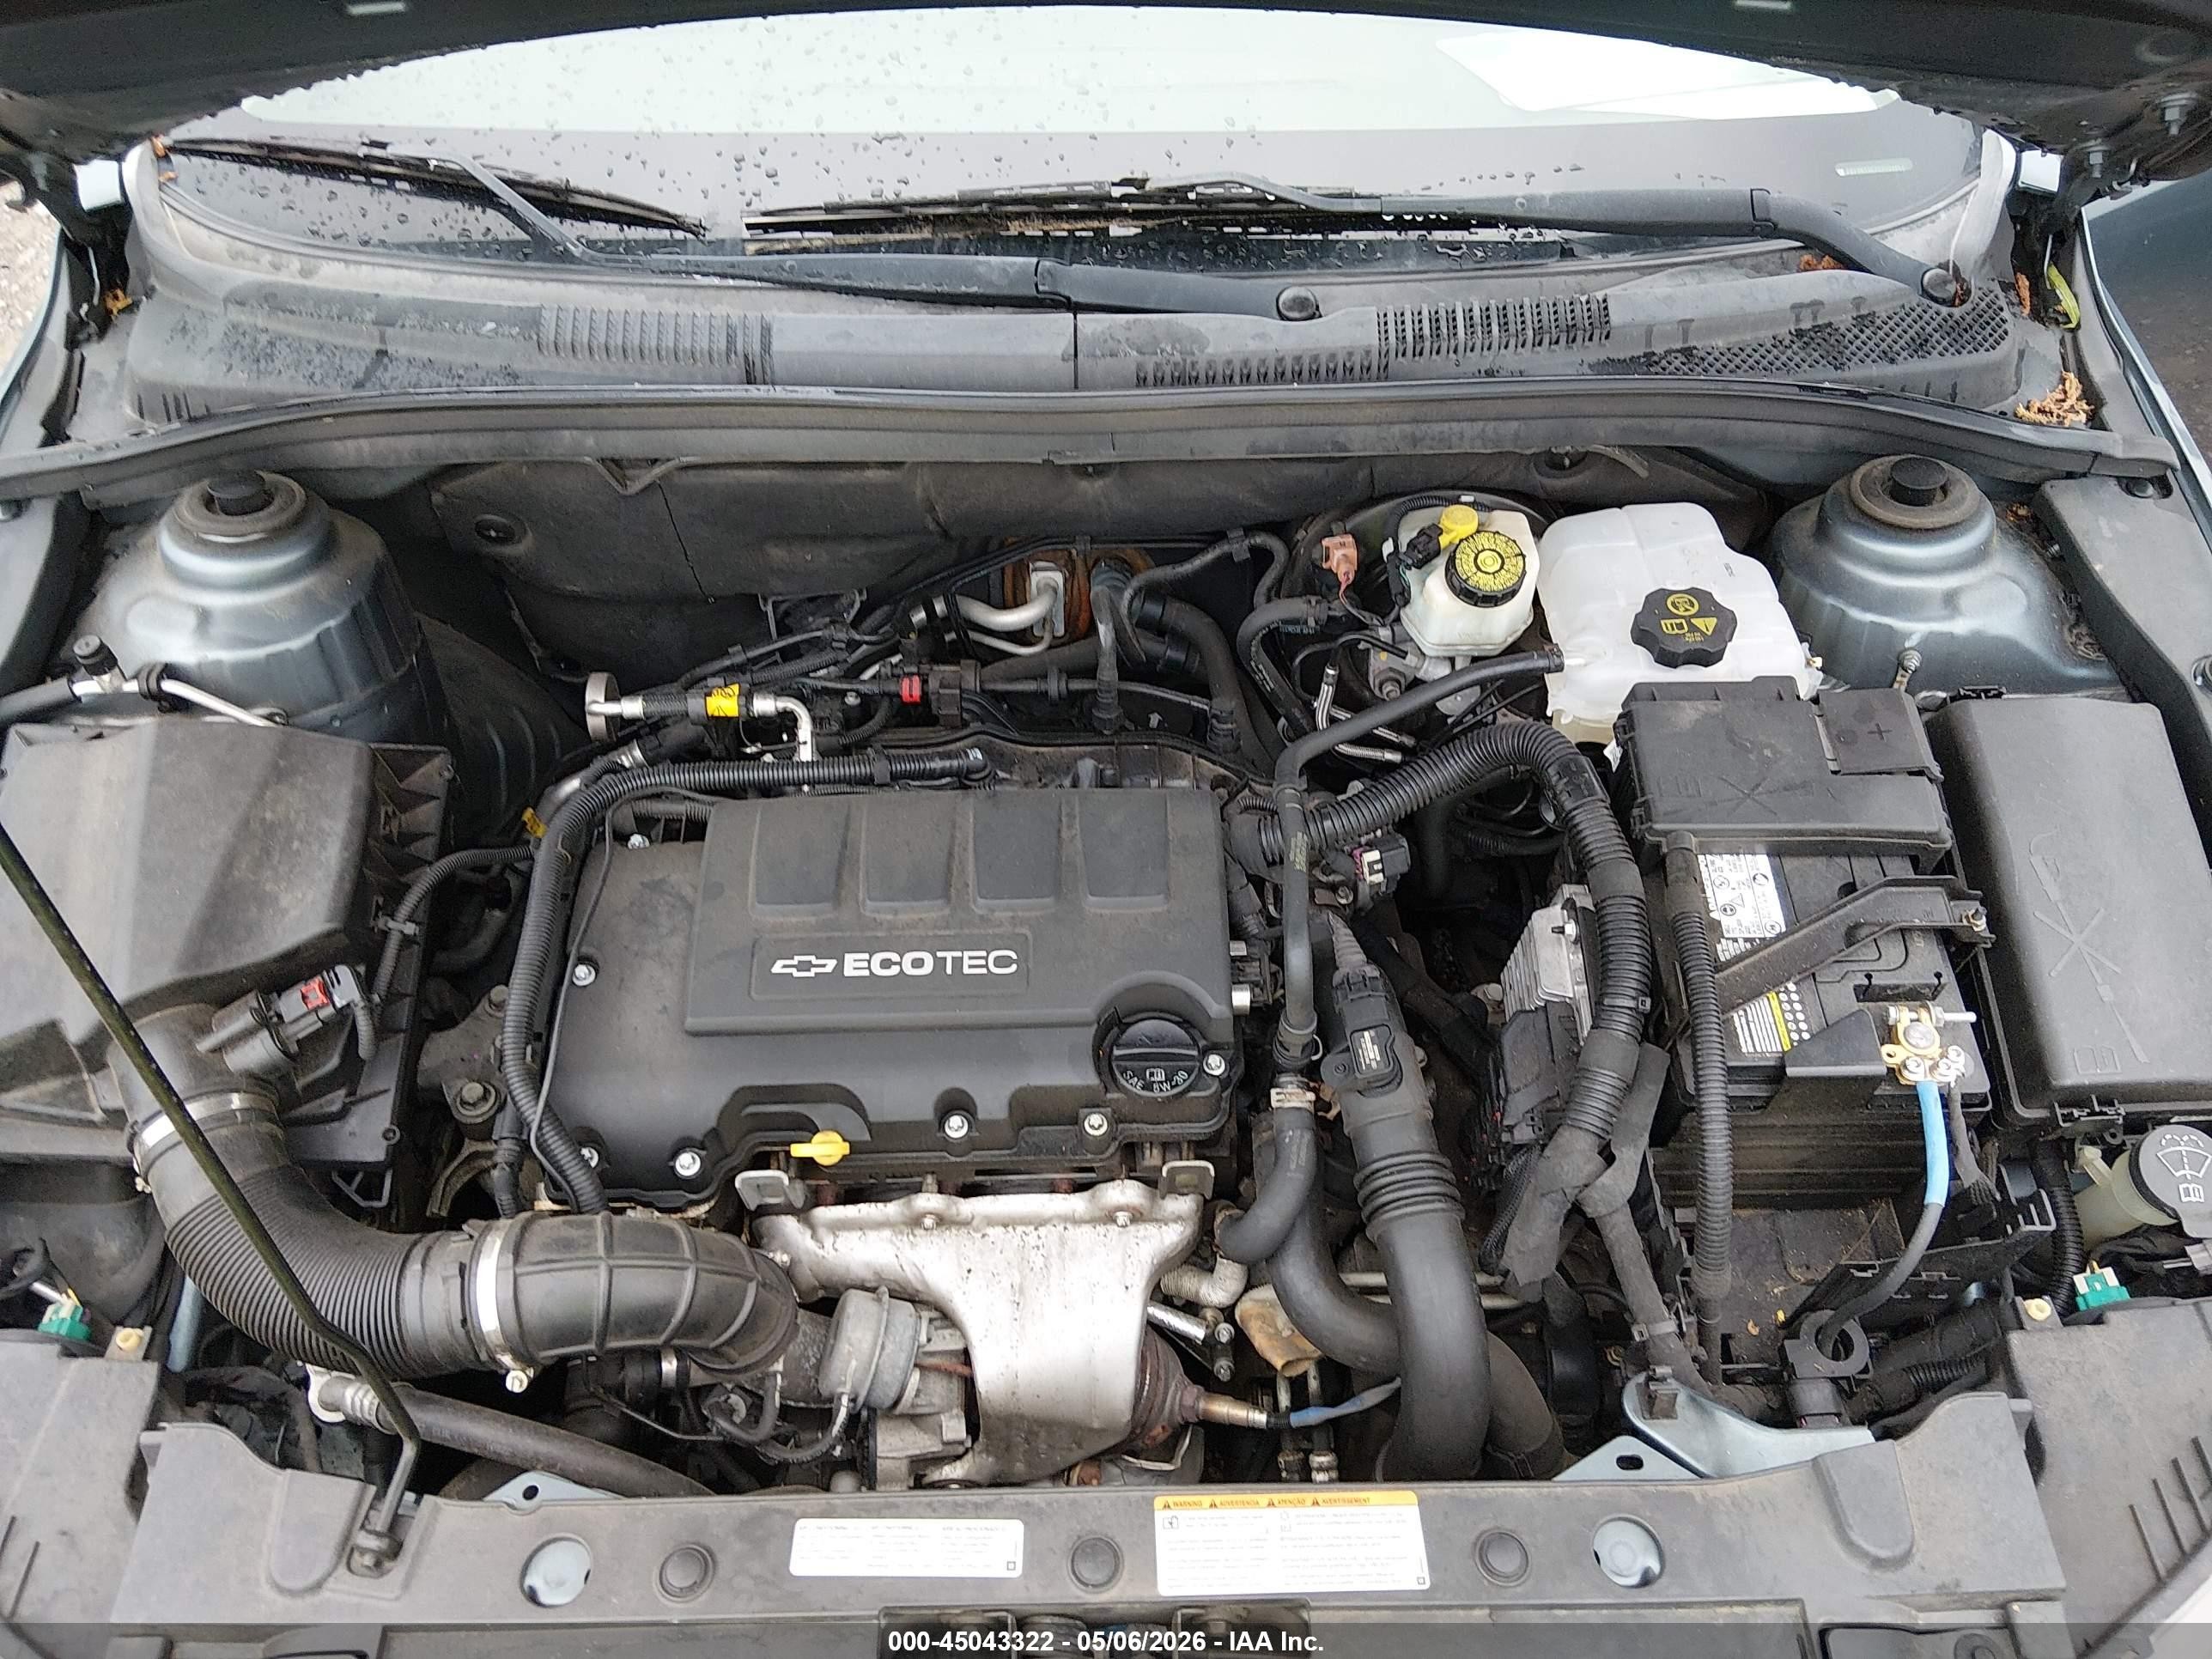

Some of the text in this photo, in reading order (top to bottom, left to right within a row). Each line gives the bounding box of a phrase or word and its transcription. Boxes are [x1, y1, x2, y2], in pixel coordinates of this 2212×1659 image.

[843, 949, 1018, 977] ECOTEC
[1123, 1070, 1145, 1091] SAE
[1172, 1499, 1203, 1509] WARNING
[1322, 1496, 1371, 1505] AVERTISSEMENT
